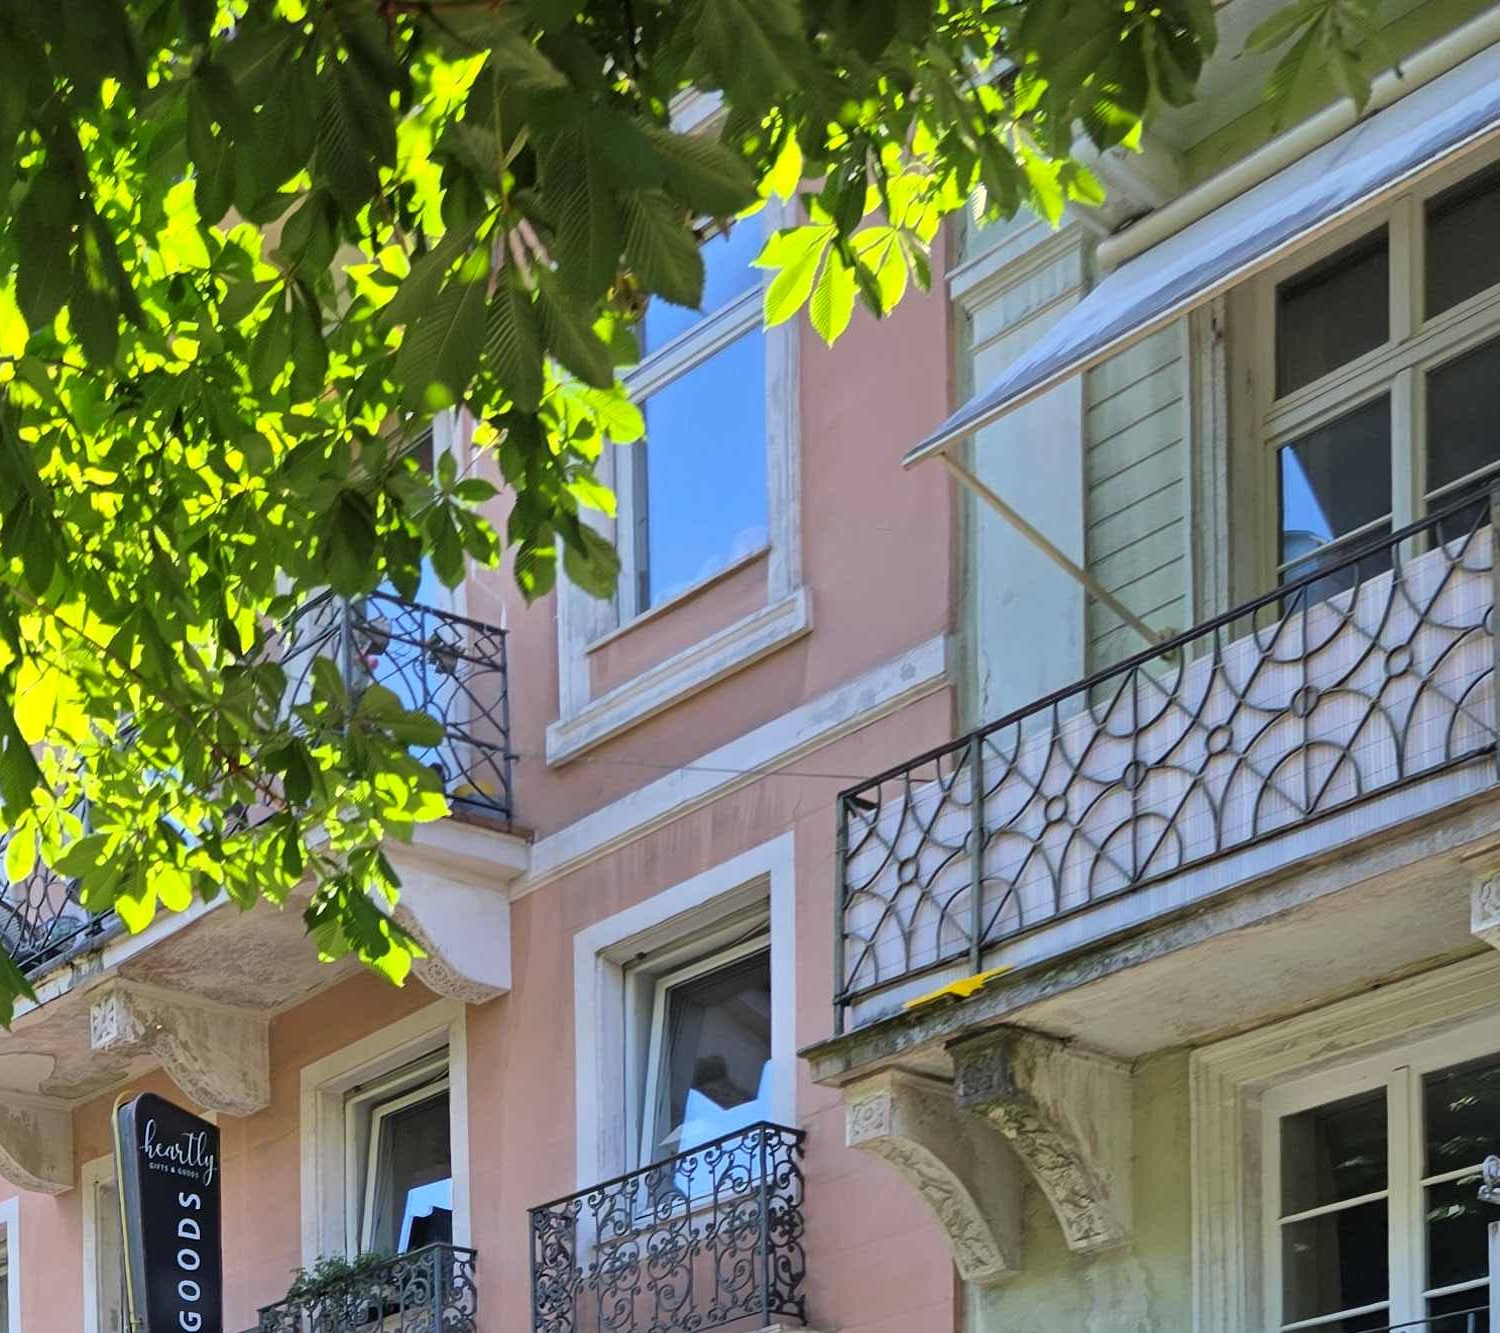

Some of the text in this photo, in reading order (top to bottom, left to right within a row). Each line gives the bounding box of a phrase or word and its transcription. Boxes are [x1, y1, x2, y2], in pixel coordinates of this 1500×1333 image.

[139, 1119, 217, 1186] heartly
[149, 1162, 169, 1173] GIFTS
[176, 1190, 204, 1333] GOODS
